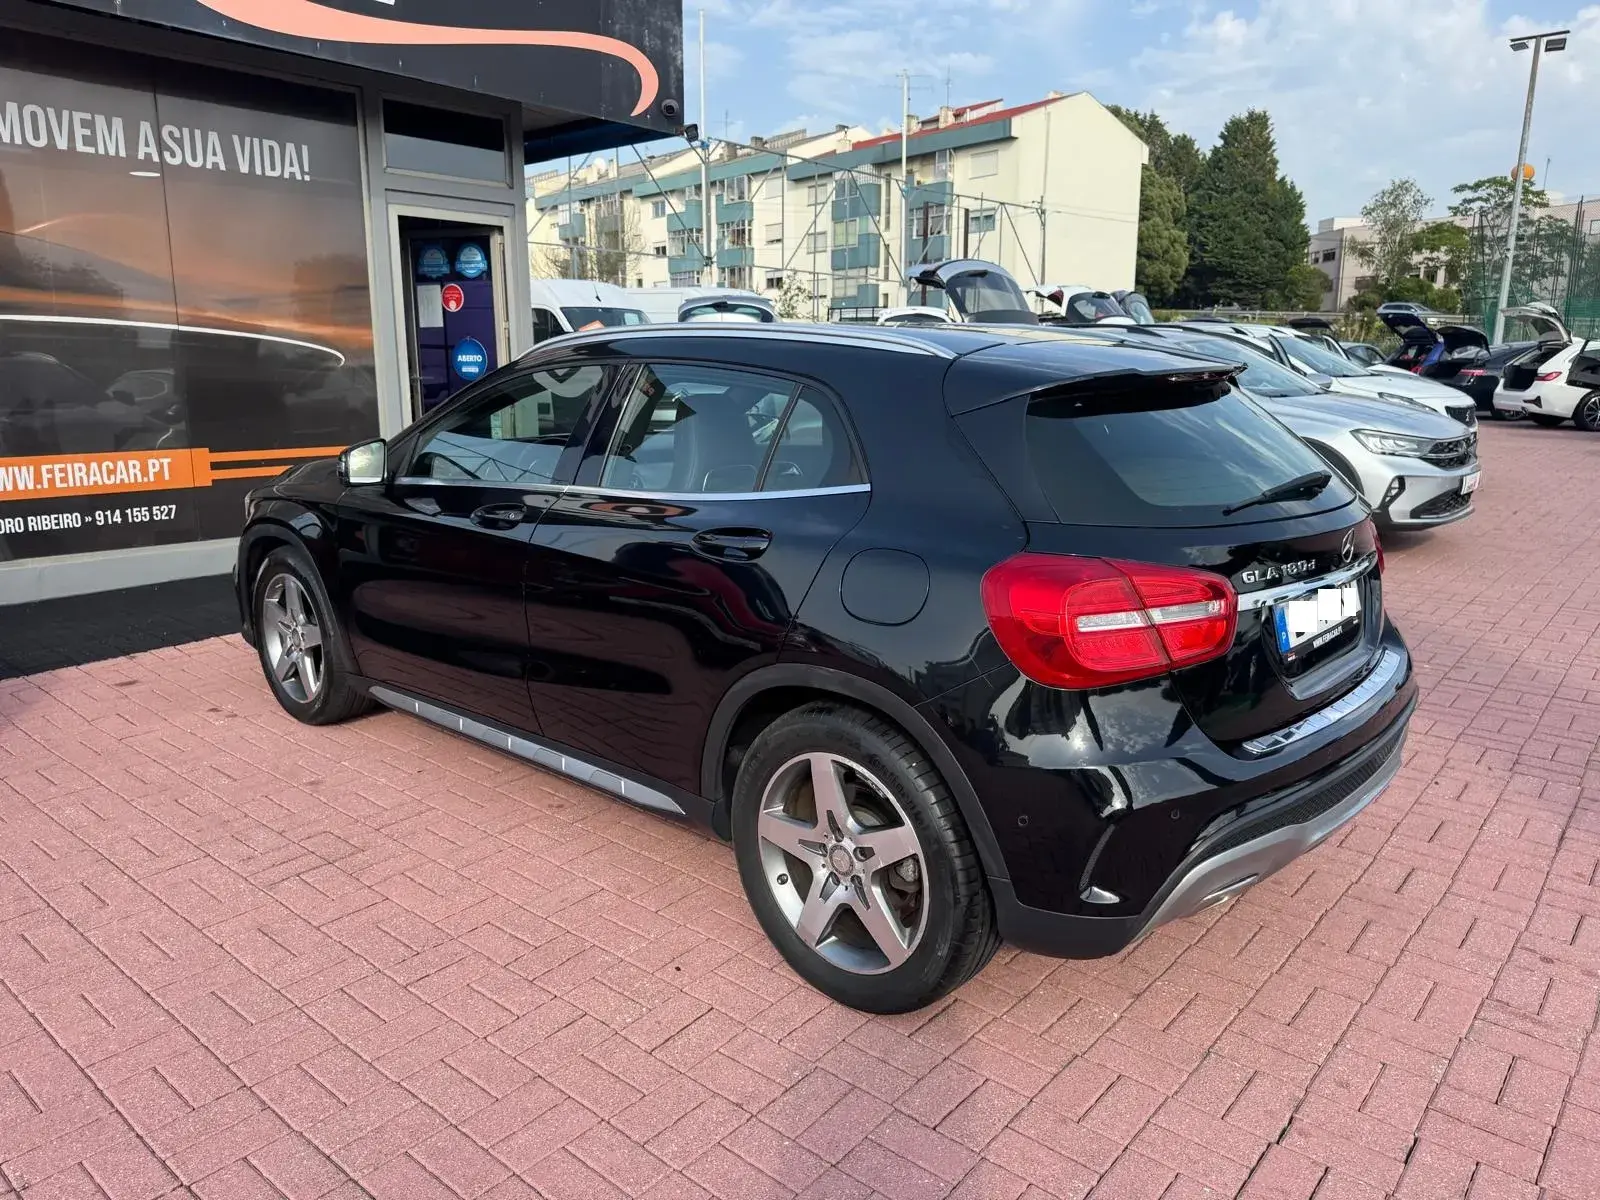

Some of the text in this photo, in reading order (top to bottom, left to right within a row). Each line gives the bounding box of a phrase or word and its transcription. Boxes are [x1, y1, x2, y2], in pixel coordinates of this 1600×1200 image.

[0, 101, 126, 158] MOVEM
[232, 134, 311, 181] VIDA!
[457, 354, 483, 362] ABERTO
[28, 512, 82, 532] RIBEIRO
[96, 510, 122, 526] 914
[125, 508, 150, 523] 155
[152, 505, 176, 520] 527
[1242, 566, 1279, 584] GLA
